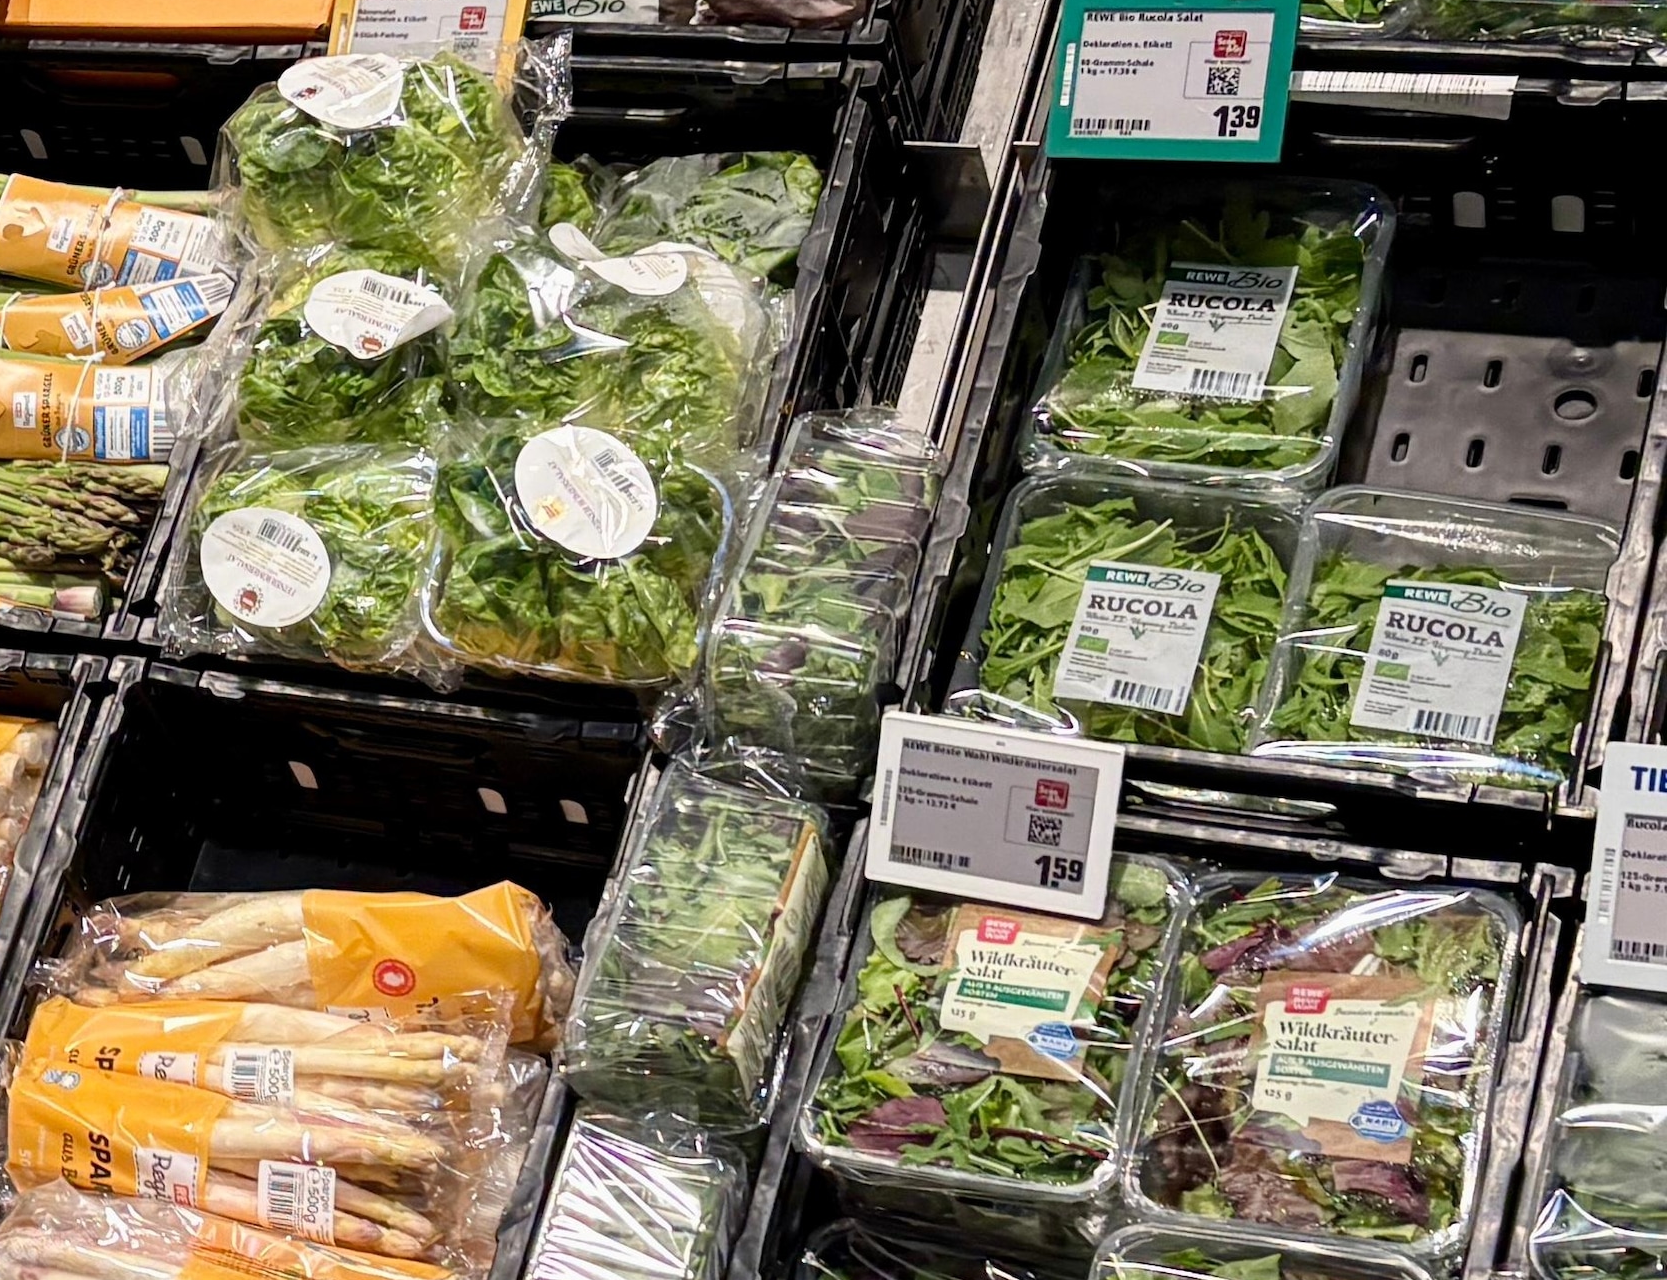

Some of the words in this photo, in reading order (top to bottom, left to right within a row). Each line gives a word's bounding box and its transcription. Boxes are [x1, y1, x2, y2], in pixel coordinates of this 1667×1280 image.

[1087, 13, 1115, 22] REWE
[1119, 13, 1135, 22] Bio
[1138, 13, 1174, 23] Rucola
[1177, 13, 1204, 22] Salat
[1213, 105, 1262, 137] 1.39
[1186, 271, 1227, 283] REWE
[1227, 270, 1284, 289] Bio
[1168, 292, 1276, 313] RUCOLA
[1106, 571, 1147, 585] REWE
[1147, 572, 1206, 594] Bio
[1088, 594, 1198, 620] RUCOLA
[1403, 588, 1448, 604] REWE
[1449, 590, 1512, 619] Bio
[1386, 610, 1505, 649] RUCOLA
[1035, 855, 1084, 889] 1.59
[971, 949, 1079, 977] Wildkräuter-
[1273, 1037, 1319, 1054] salat
[1278, 1020, 1400, 1046] Wildkräuter-
